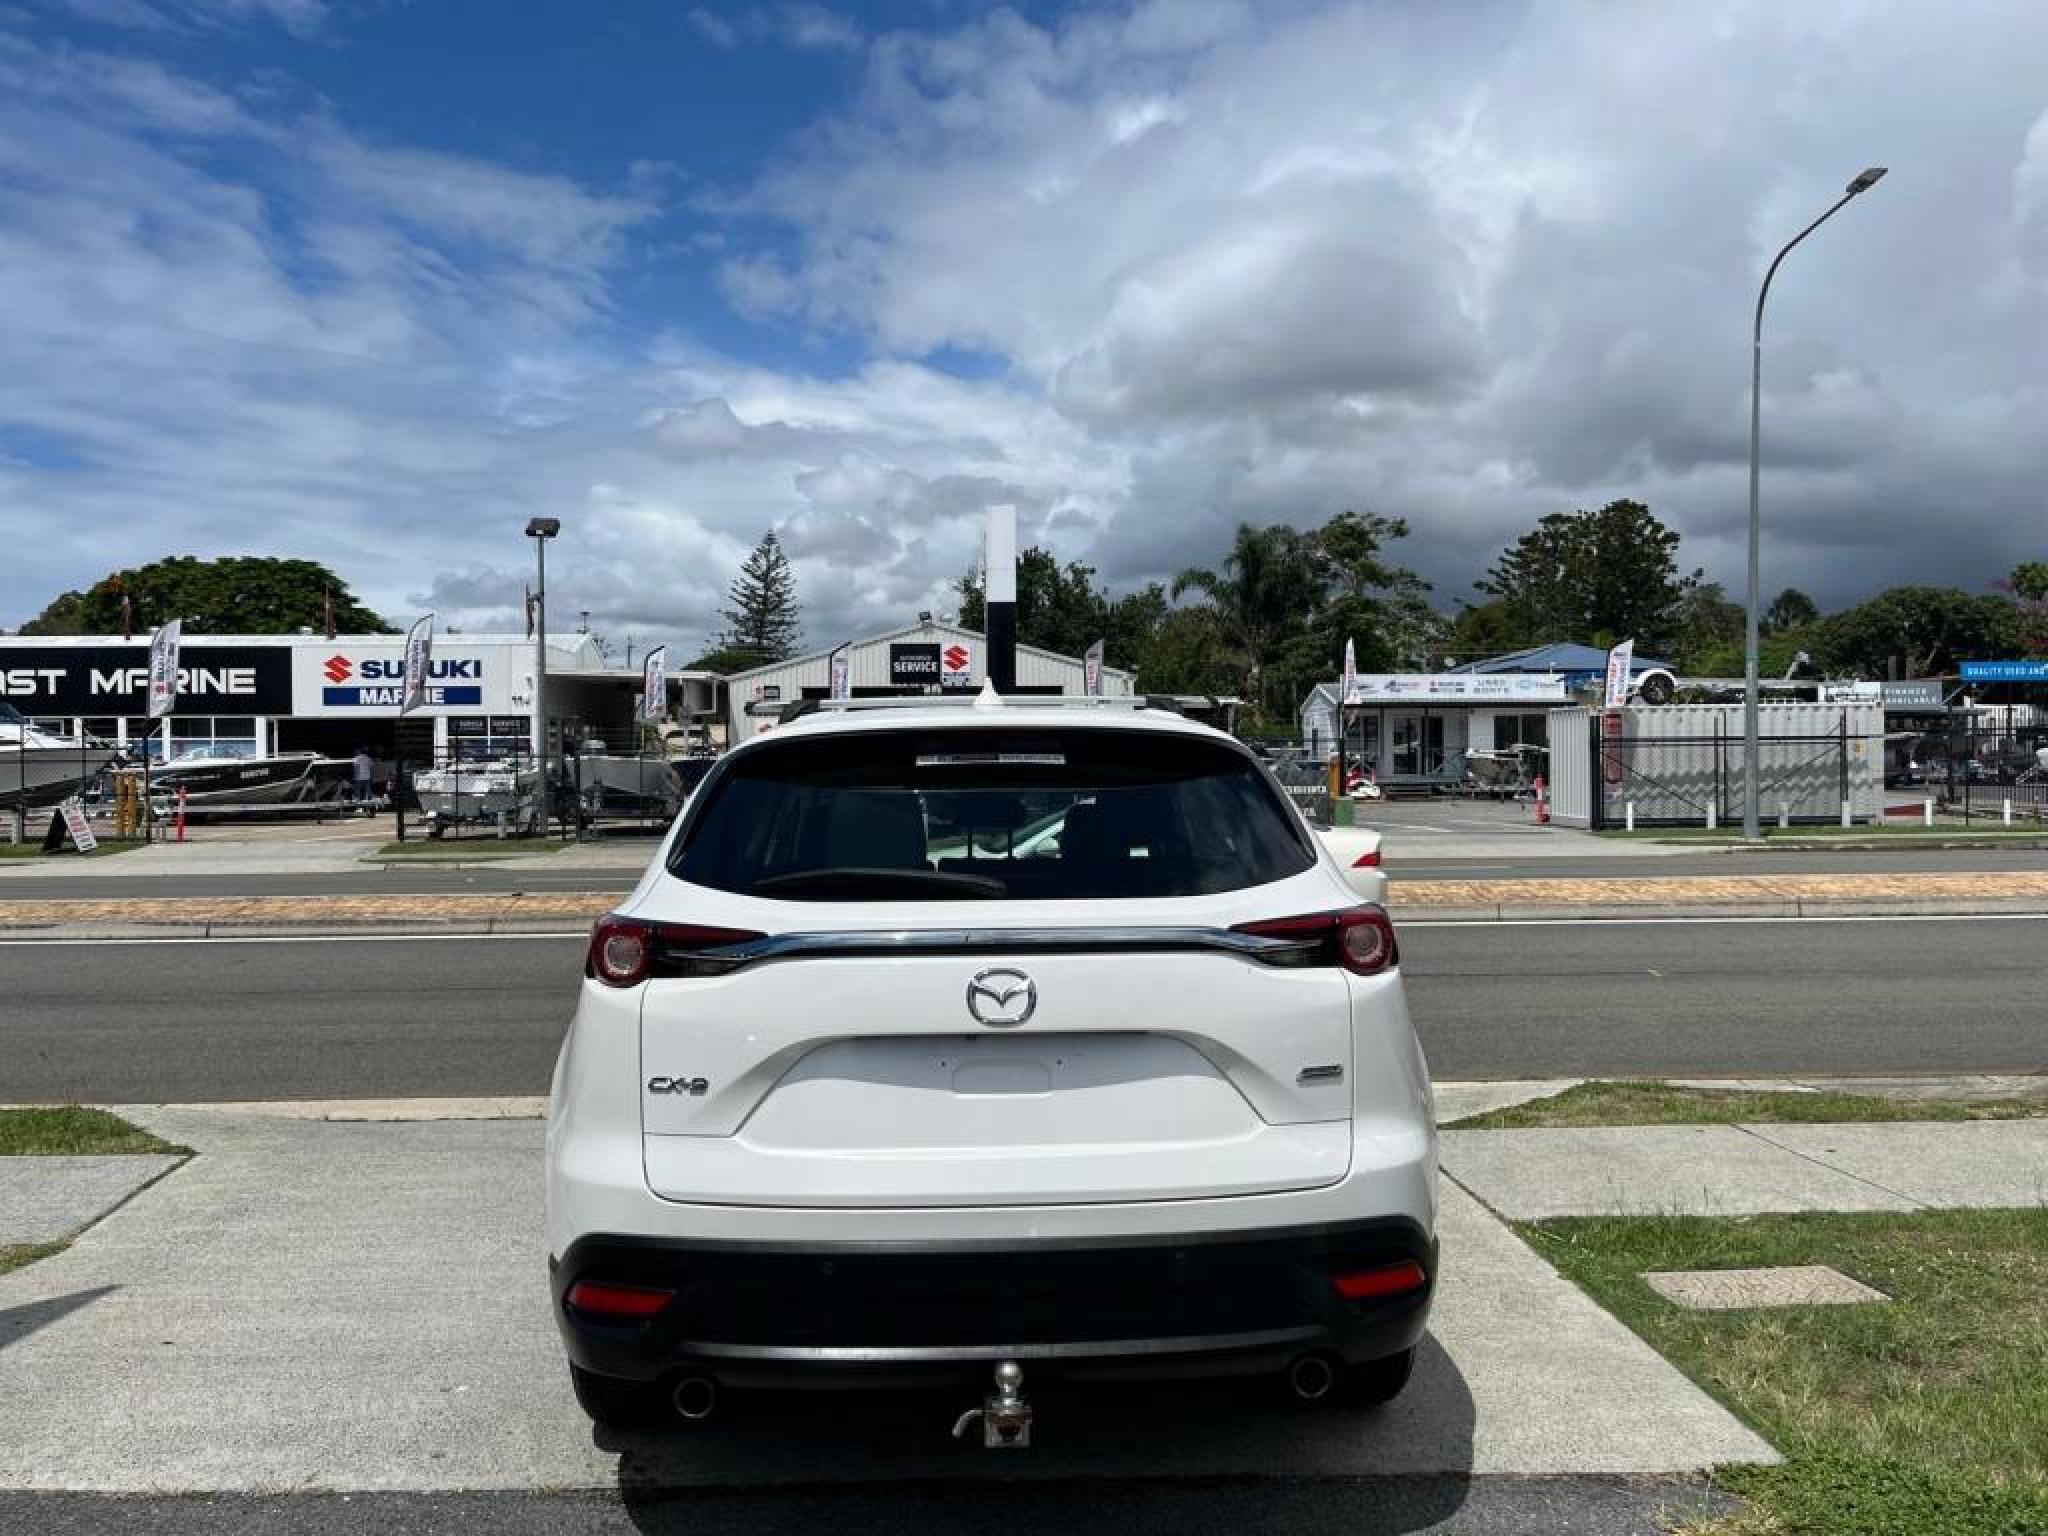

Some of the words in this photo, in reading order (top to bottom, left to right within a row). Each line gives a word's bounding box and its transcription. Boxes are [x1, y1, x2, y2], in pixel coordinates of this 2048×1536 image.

[360, 660, 482, 679] SUUKI
[893, 661, 938, 672] SERVICE
[0, 668, 67, 695] ST
[648, 1077, 709, 1096] CX-9
